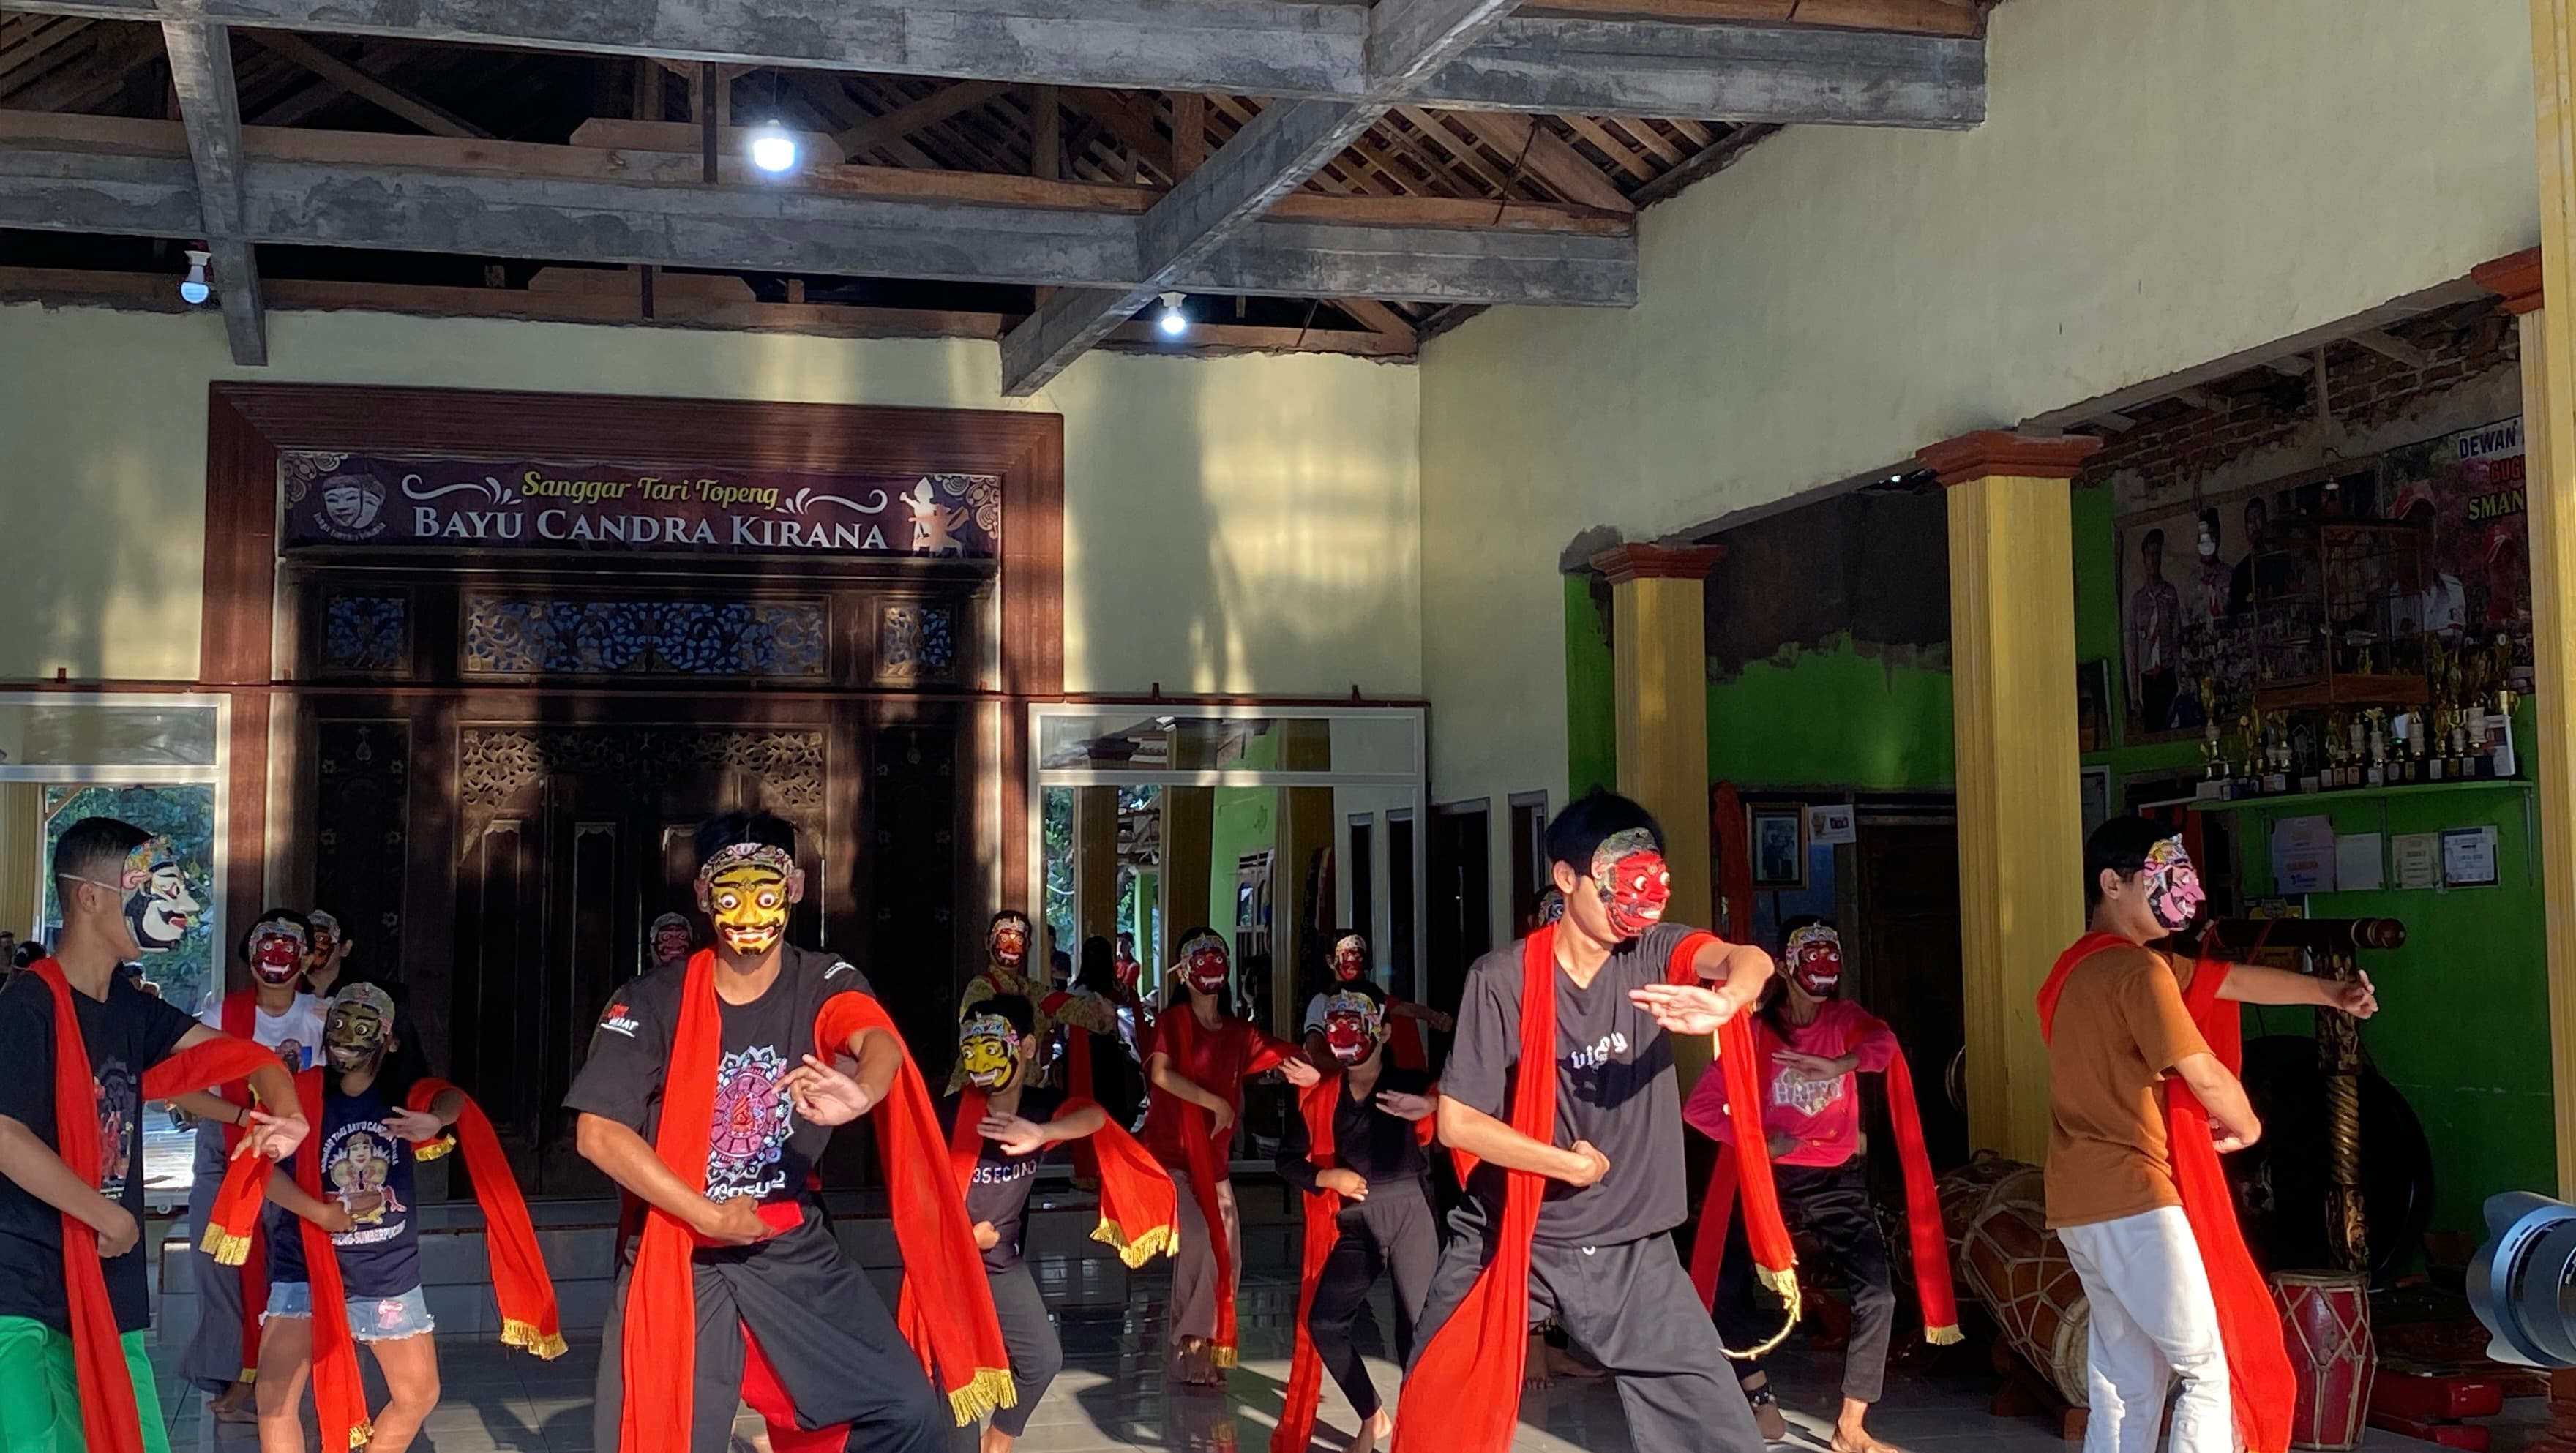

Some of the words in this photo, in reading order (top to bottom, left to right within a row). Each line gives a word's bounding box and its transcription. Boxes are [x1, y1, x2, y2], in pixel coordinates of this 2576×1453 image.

[2459, 427, 2517, 459] DEWAN
[521, 471, 632, 503] Sanggar
[638, 477, 691, 501] Tari
[695, 479, 779, 510] Topeng
[413, 506, 525, 539] BAYU
[536, 509, 719, 545] CANDRA
[730, 515, 891, 549] KIRANA
